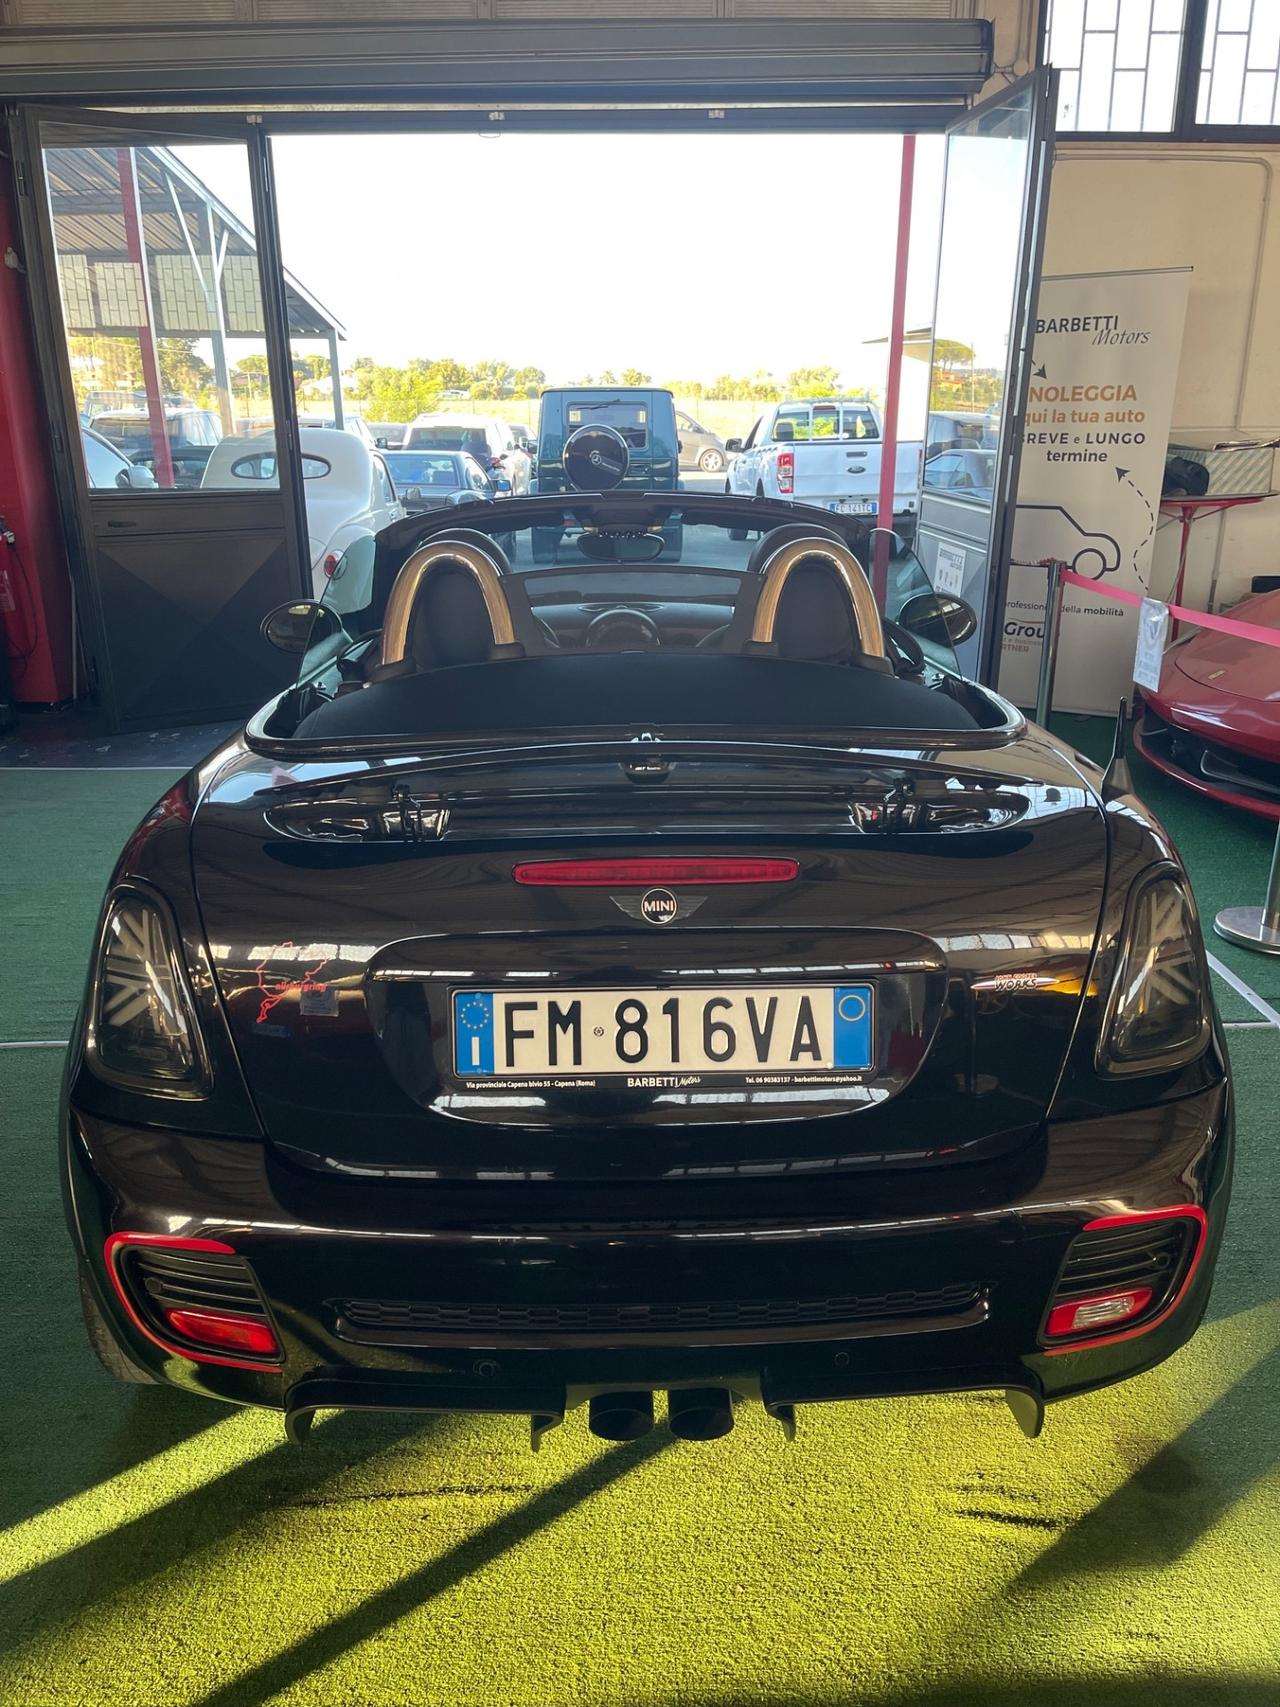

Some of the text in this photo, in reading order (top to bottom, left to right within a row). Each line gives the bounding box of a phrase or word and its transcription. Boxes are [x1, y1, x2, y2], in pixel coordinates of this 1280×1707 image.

[1036, 315, 1119, 334] BARBETTI
[1092, 330, 1151, 346] Motors
[1029, 385, 1138, 403] NOLEGGIA
[1052, 409, 1066, 424] la
[1071, 410, 1099, 424] tua
[1103, 409, 1145, 424] auto
[1022, 432, 1146, 445] REVE e LUNGO
[1047, 449, 1108, 462] termine
[1007, 601, 1046, 610] rofession
[1084, 607, 1124, 617] mobilità
[644, 900, 674, 912] MINI
[996, 978, 1038, 991] WORKS
[505, 996, 823, 1067] FM 816VA
[476, 1081, 506, 1090] provinciale
[507, 1081, 528, 1089] Capena
[554, 1080, 575, 1088] Capena
[627, 1077, 677, 1087] BARBETTI
